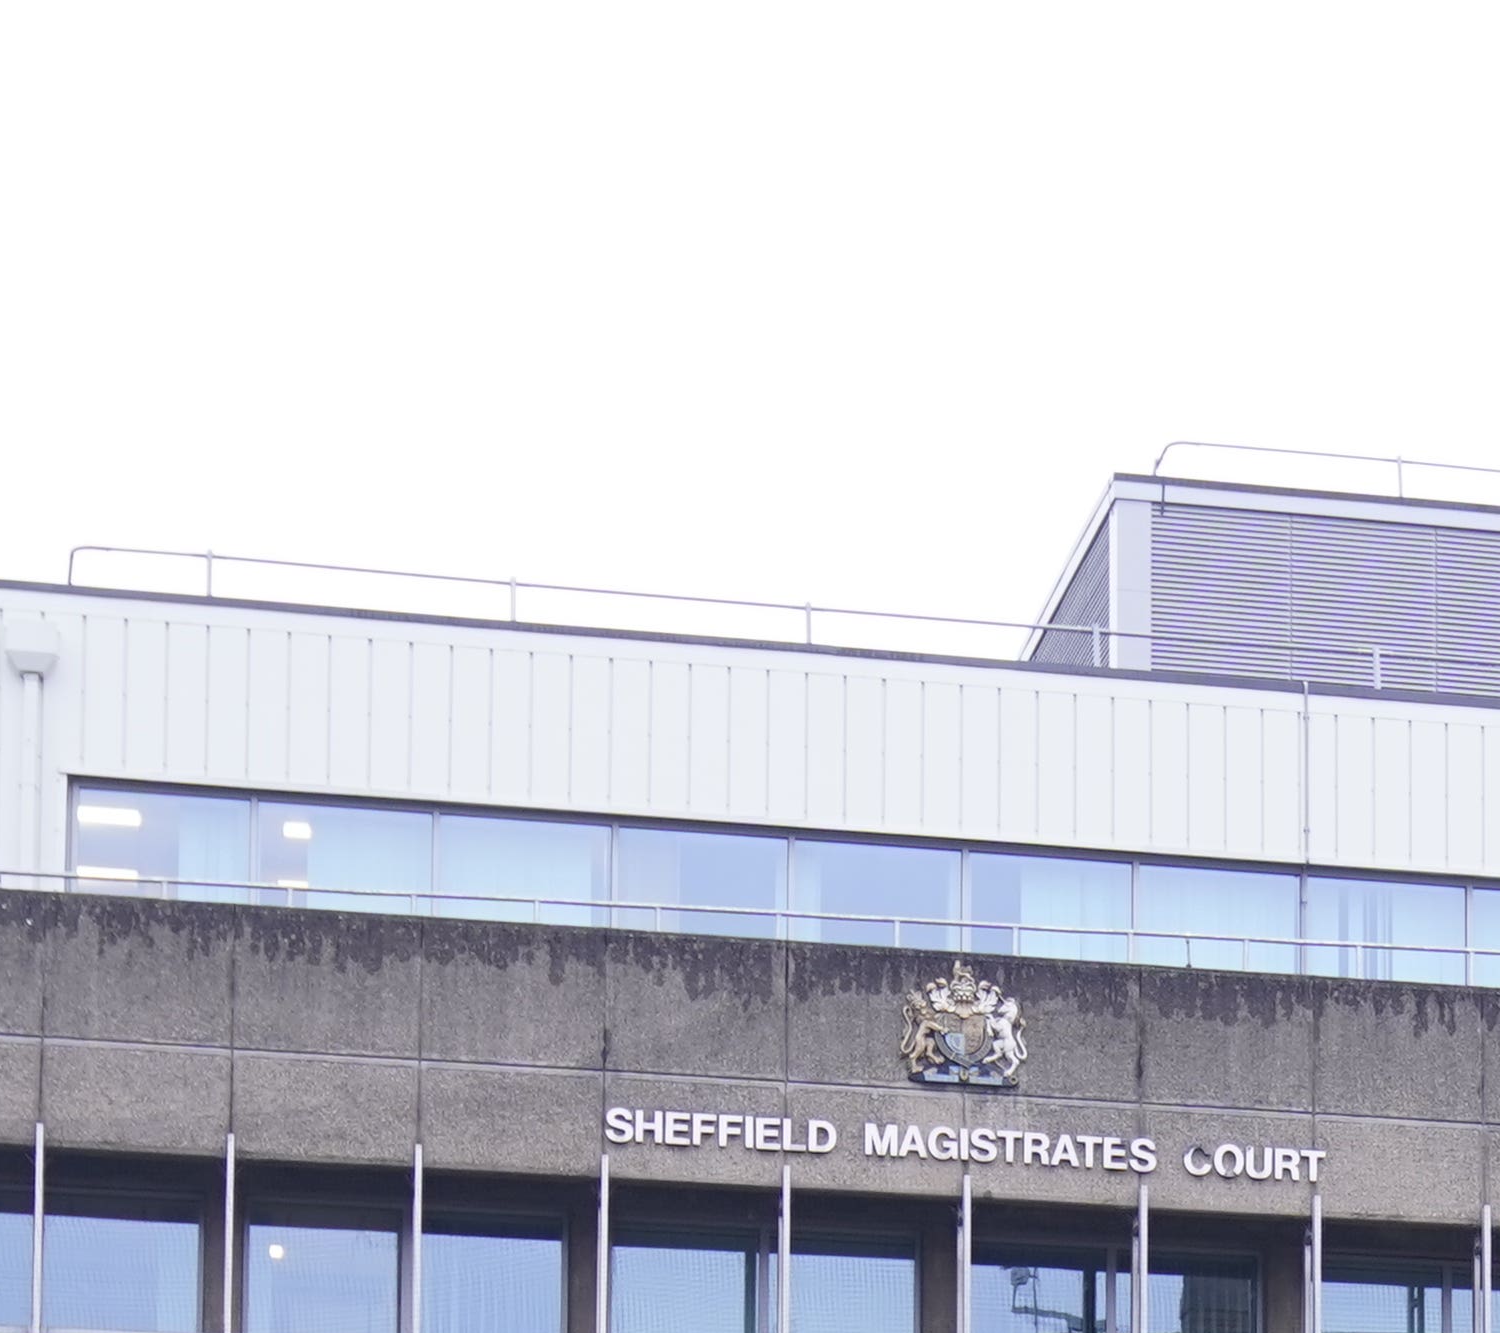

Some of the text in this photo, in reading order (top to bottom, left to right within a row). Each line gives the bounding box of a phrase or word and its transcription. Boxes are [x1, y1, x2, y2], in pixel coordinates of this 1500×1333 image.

[605, 1107, 1327, 1183] SHEFFIELD MAGISTRATES COURT
